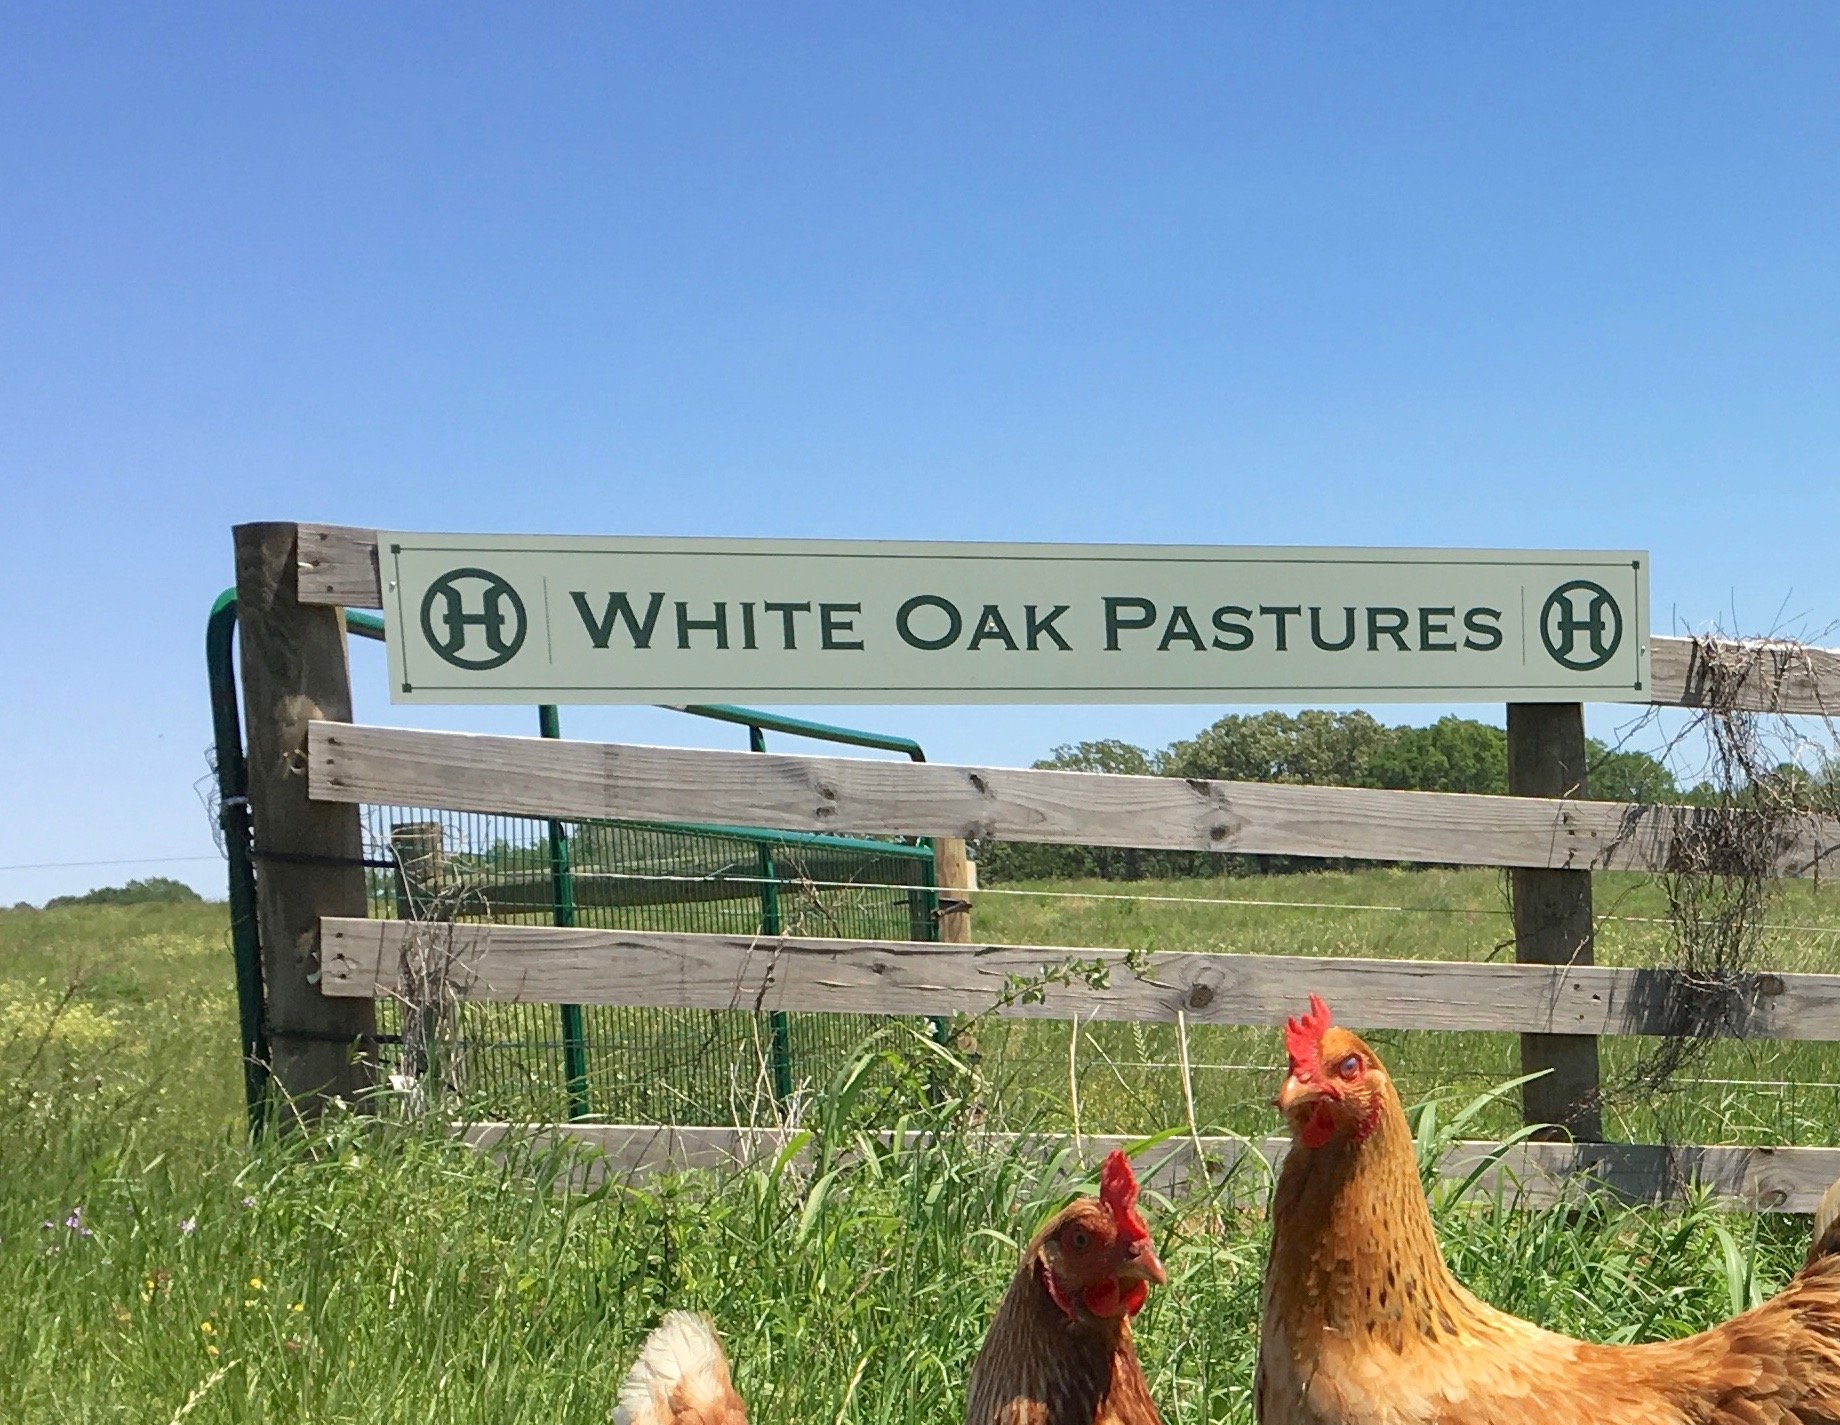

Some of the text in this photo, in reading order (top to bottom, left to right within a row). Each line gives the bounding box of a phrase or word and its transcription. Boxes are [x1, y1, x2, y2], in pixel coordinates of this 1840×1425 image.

[568, 591, 1503, 654] WHITE OAK PASTURES
